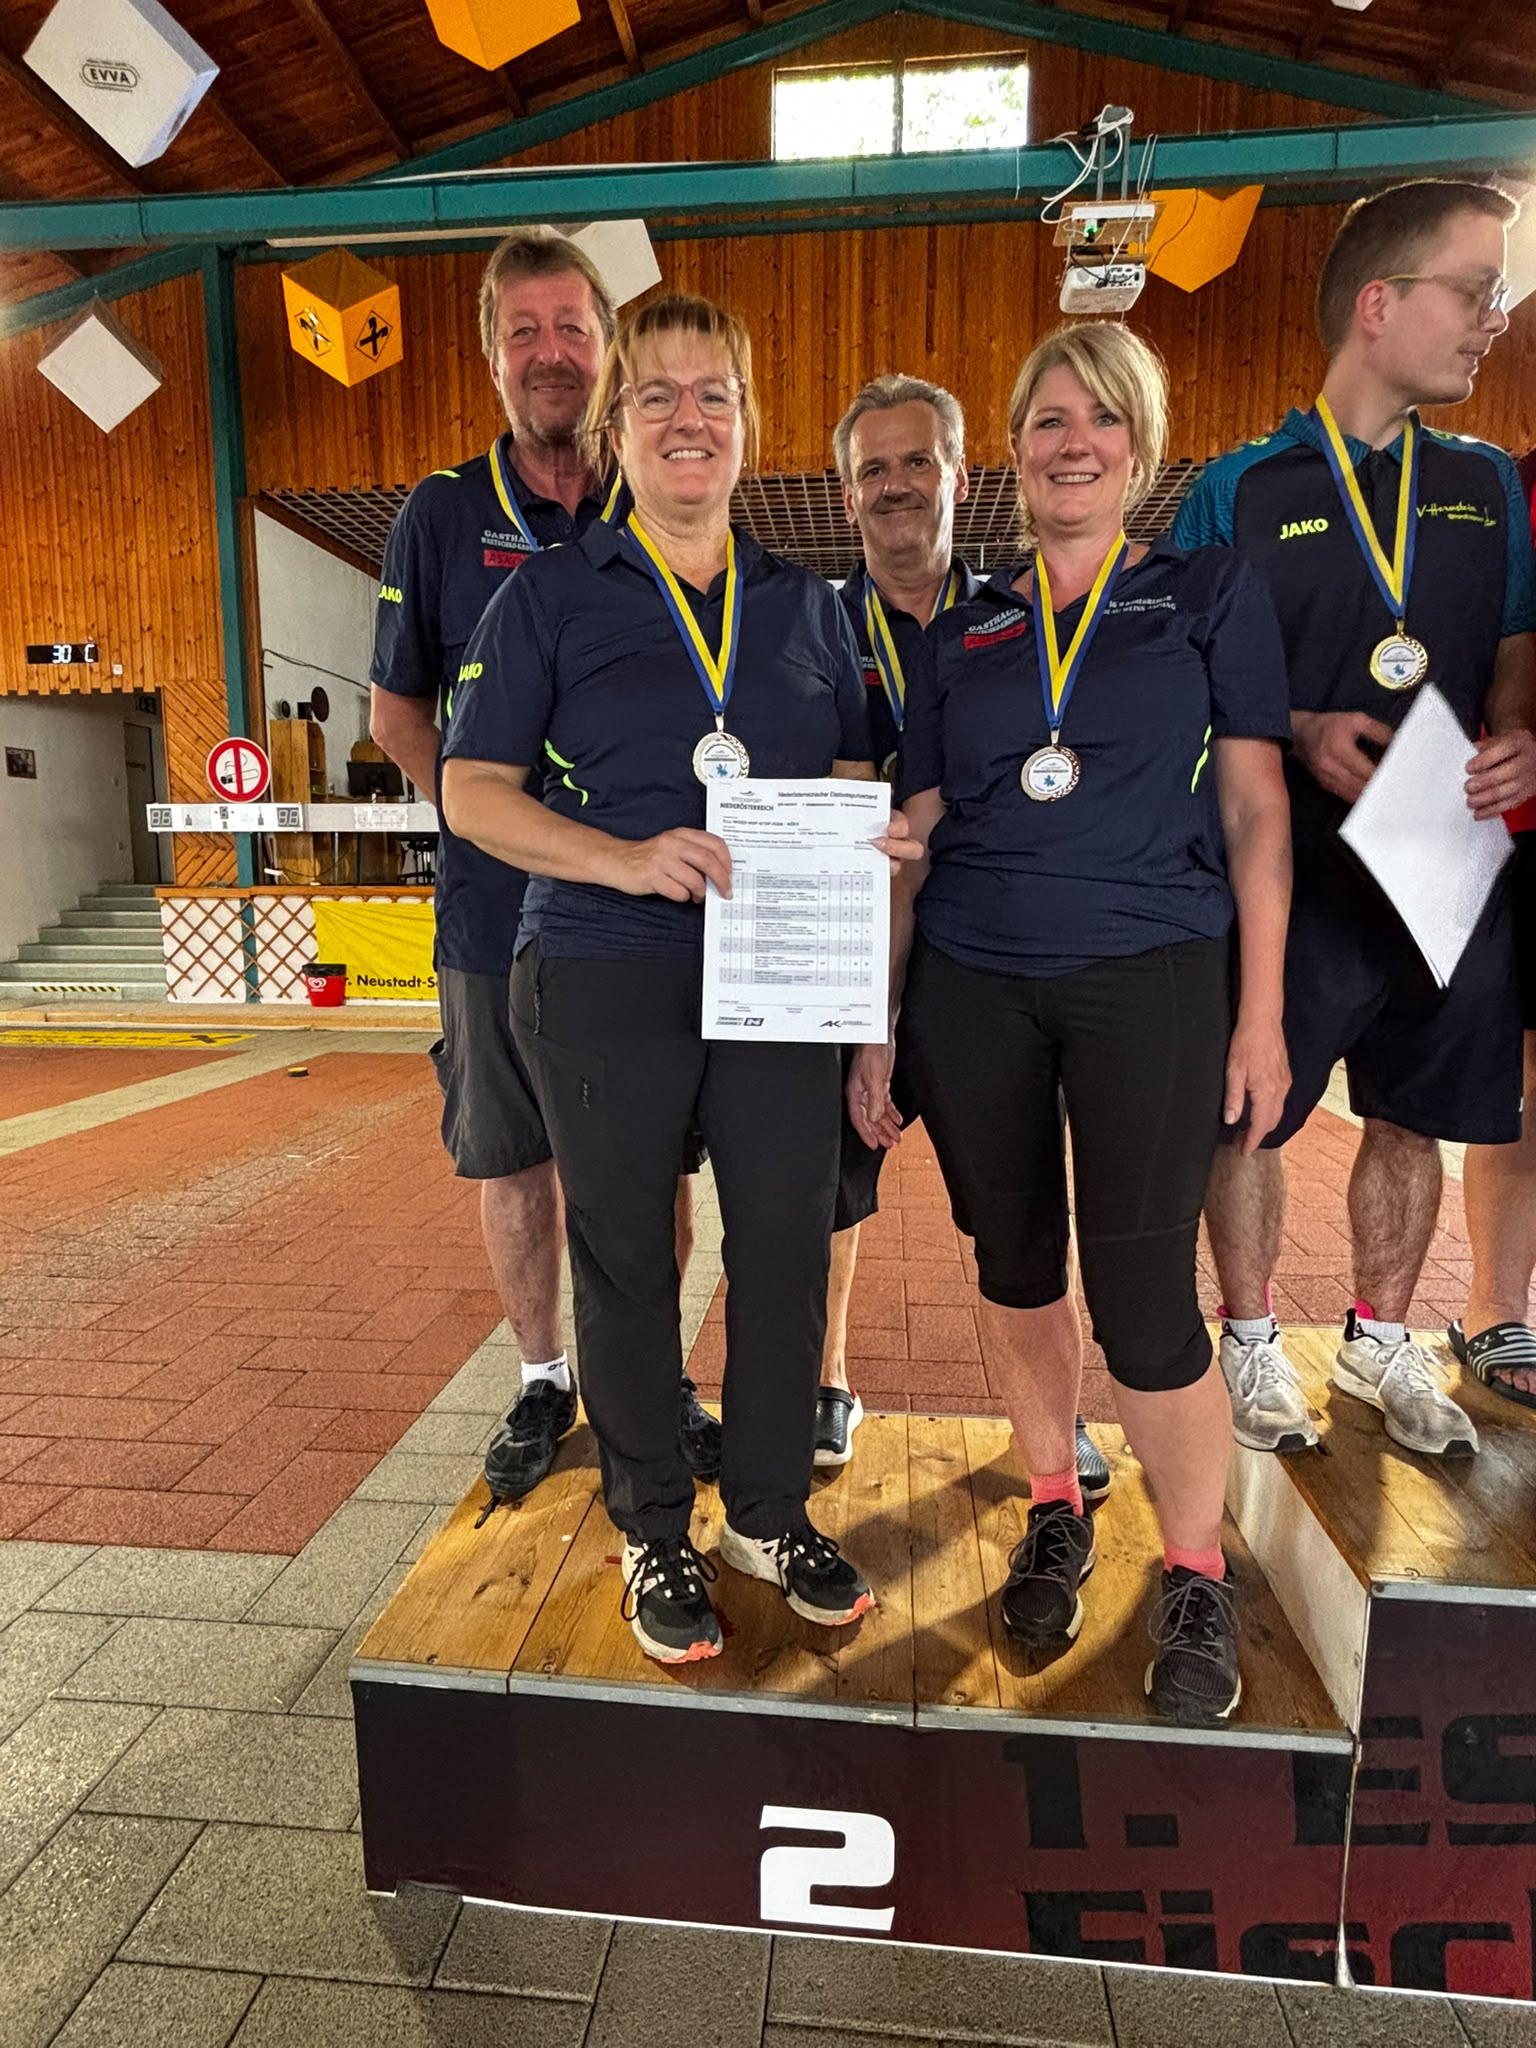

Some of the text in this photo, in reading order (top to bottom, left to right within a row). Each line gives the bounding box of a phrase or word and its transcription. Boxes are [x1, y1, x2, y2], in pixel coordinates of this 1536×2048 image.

[89, 67, 131, 85] EVVA
[483, 529, 529, 544] GASTHA
[1280, 517, 1329, 540] JAKO
[379, 584, 403, 604] AKO
[52, 644, 73, 664] 30
[760, 1805, 895, 1929] 2
